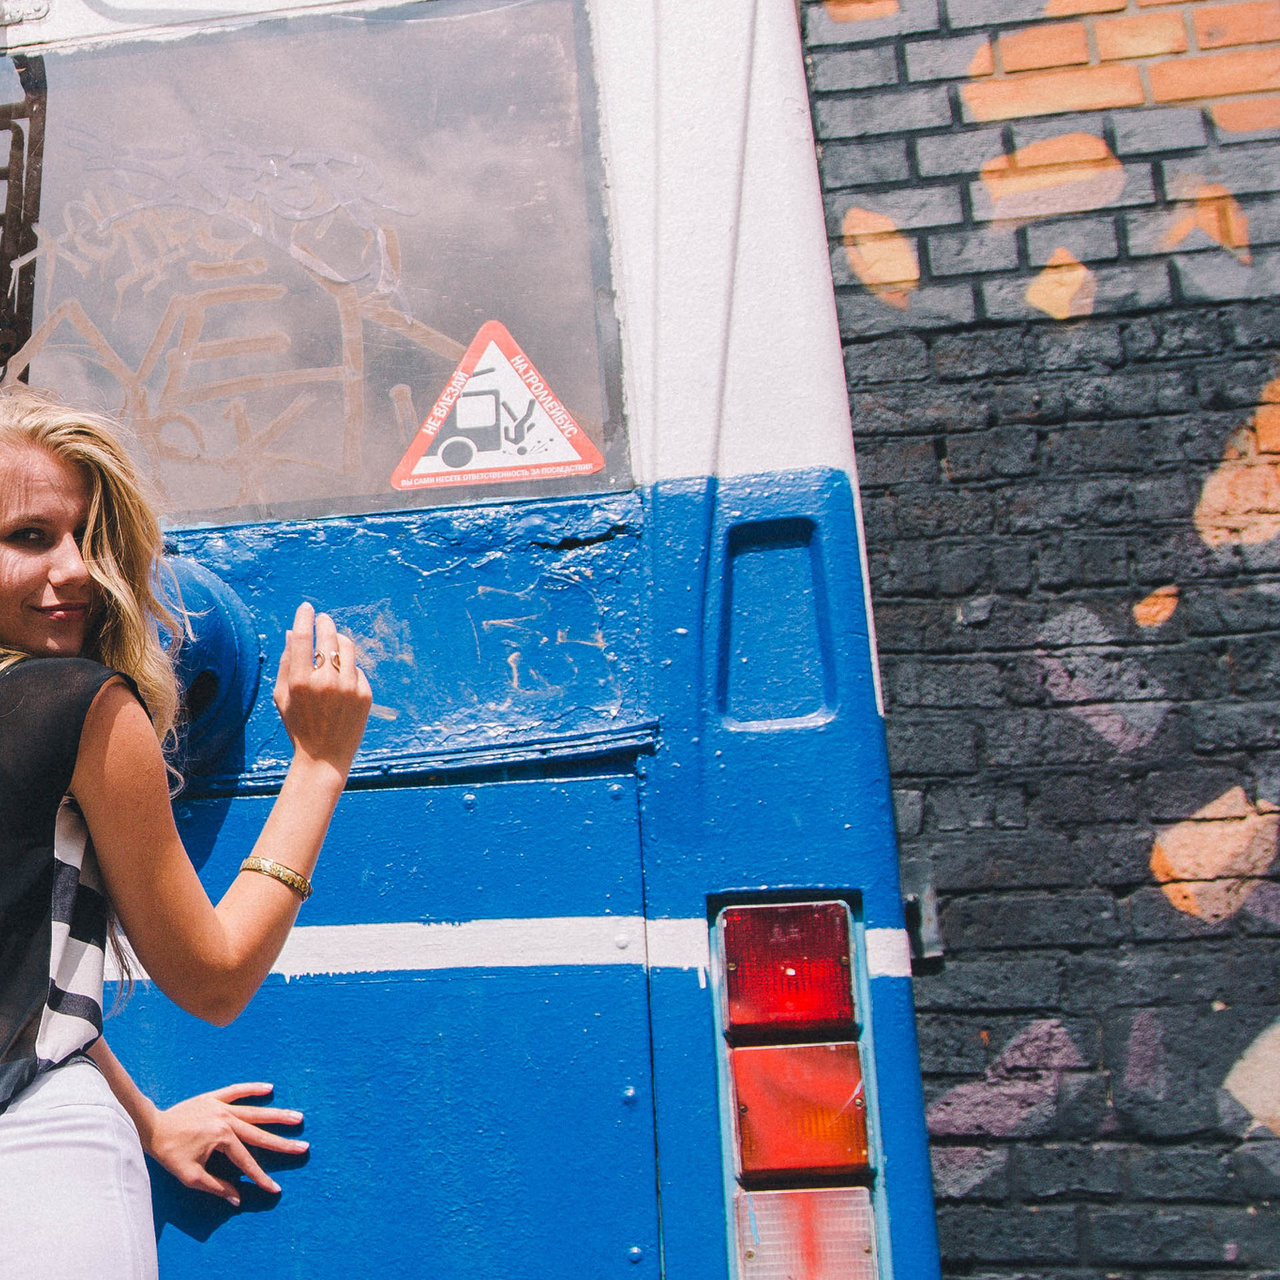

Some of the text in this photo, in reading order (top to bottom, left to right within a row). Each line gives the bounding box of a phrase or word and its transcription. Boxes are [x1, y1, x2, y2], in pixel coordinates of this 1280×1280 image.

[422, 370, 469, 436] НЕ ВЛЕЗАЙ
[510, 354, 578, 437] НА ТРОЛЛЕЙБУС
[401, 463, 593, 486] ВЫ САМИ НЕСЕТЕ ОТВЕТСТВЕННОСТЬ ЗА ПОСЛЕДСТВИЯ
